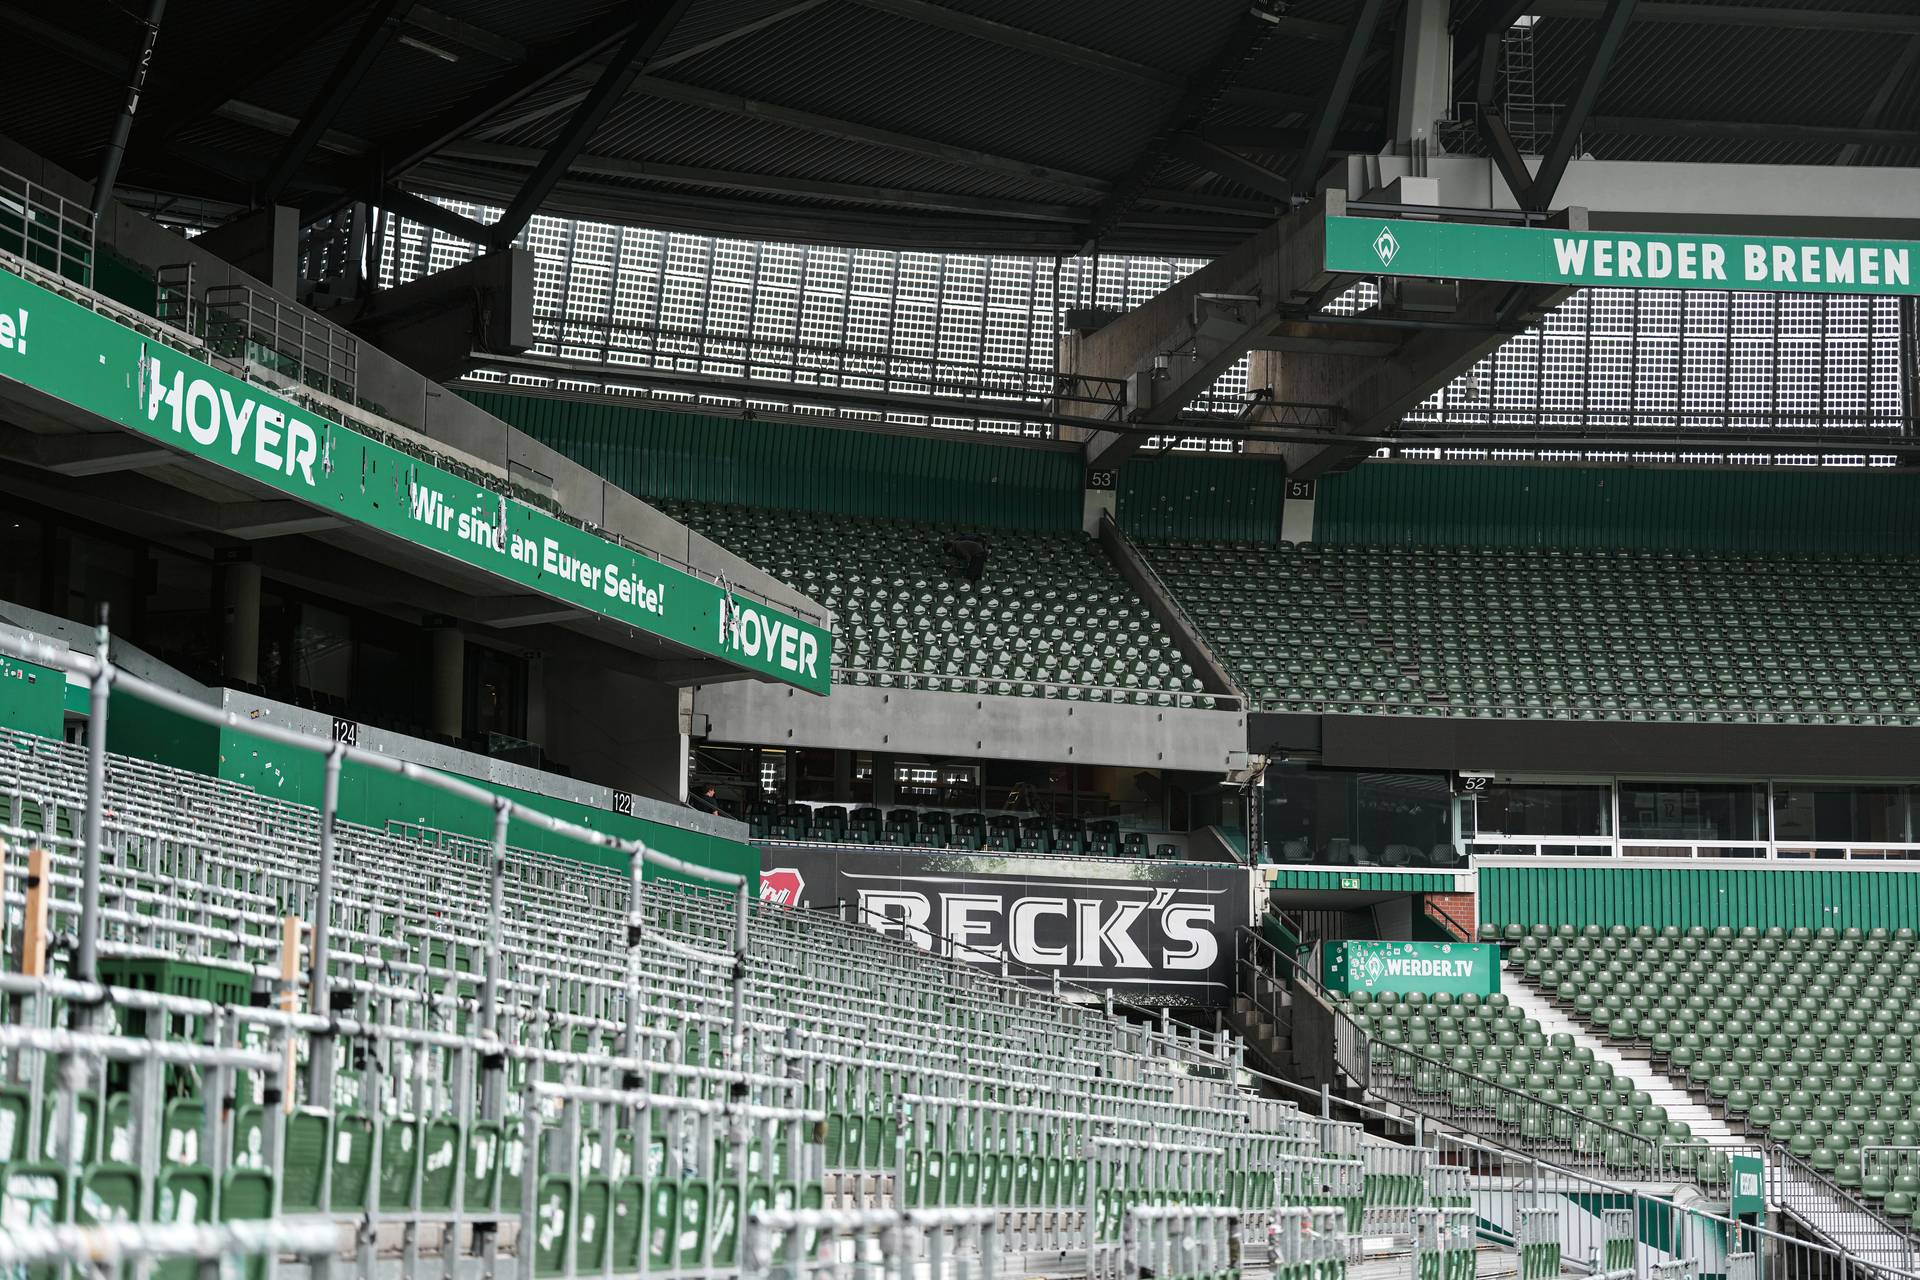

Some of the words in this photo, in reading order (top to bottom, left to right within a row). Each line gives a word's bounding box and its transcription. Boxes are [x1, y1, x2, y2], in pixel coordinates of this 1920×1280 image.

[1553, 238, 1728, 281] WERDER
[1743, 244, 1910, 285] BREMEN
[147, 356, 318, 487] HOYER
[1092, 473, 1111, 486] 53
[1292, 484, 1309, 496] 51
[409, 482, 454, 532] Wir
[510, 533, 538, 567] an
[543, 537, 602, 591] Eurer
[603, 564, 665, 616] Seite!
[718, 598, 818, 679] HOYER
[334, 720, 355, 746] 124
[1465, 777, 1486, 790] 52
[614, 793, 631, 814] 122
[857, 888, 1219, 970] BECK'S
